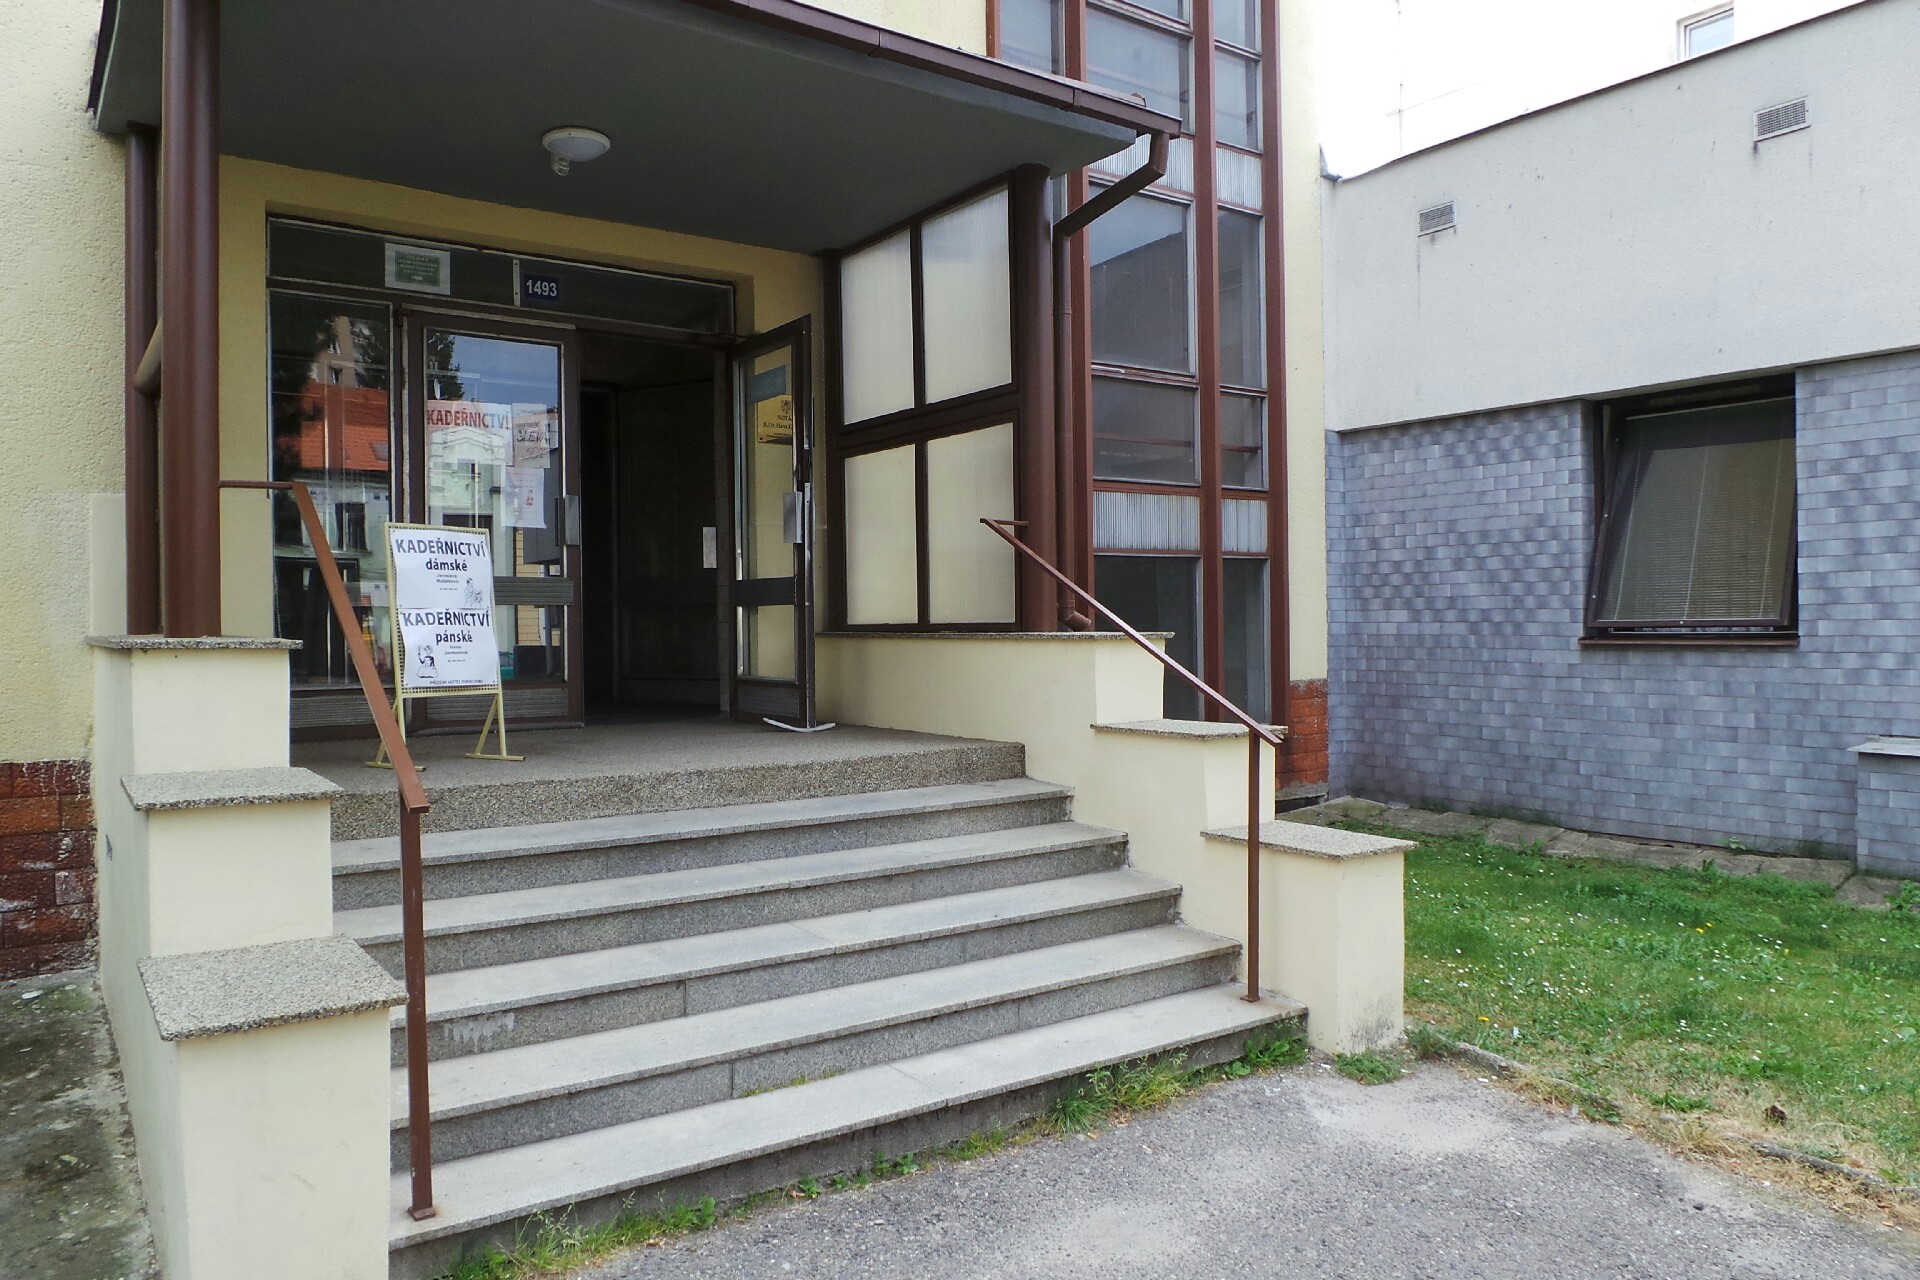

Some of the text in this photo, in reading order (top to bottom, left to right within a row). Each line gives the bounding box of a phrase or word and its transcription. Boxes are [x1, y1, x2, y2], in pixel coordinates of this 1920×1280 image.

[526, 279, 558, 297] 1493
[427, 408, 509, 430] KADEŘNICTVÍ
[395, 537, 486, 557] KADEŘNICTVÍ
[425, 557, 468, 572] dámské
[402, 608, 490, 627] KADEŘNICTVÍ
[435, 629, 473, 646] pánské
